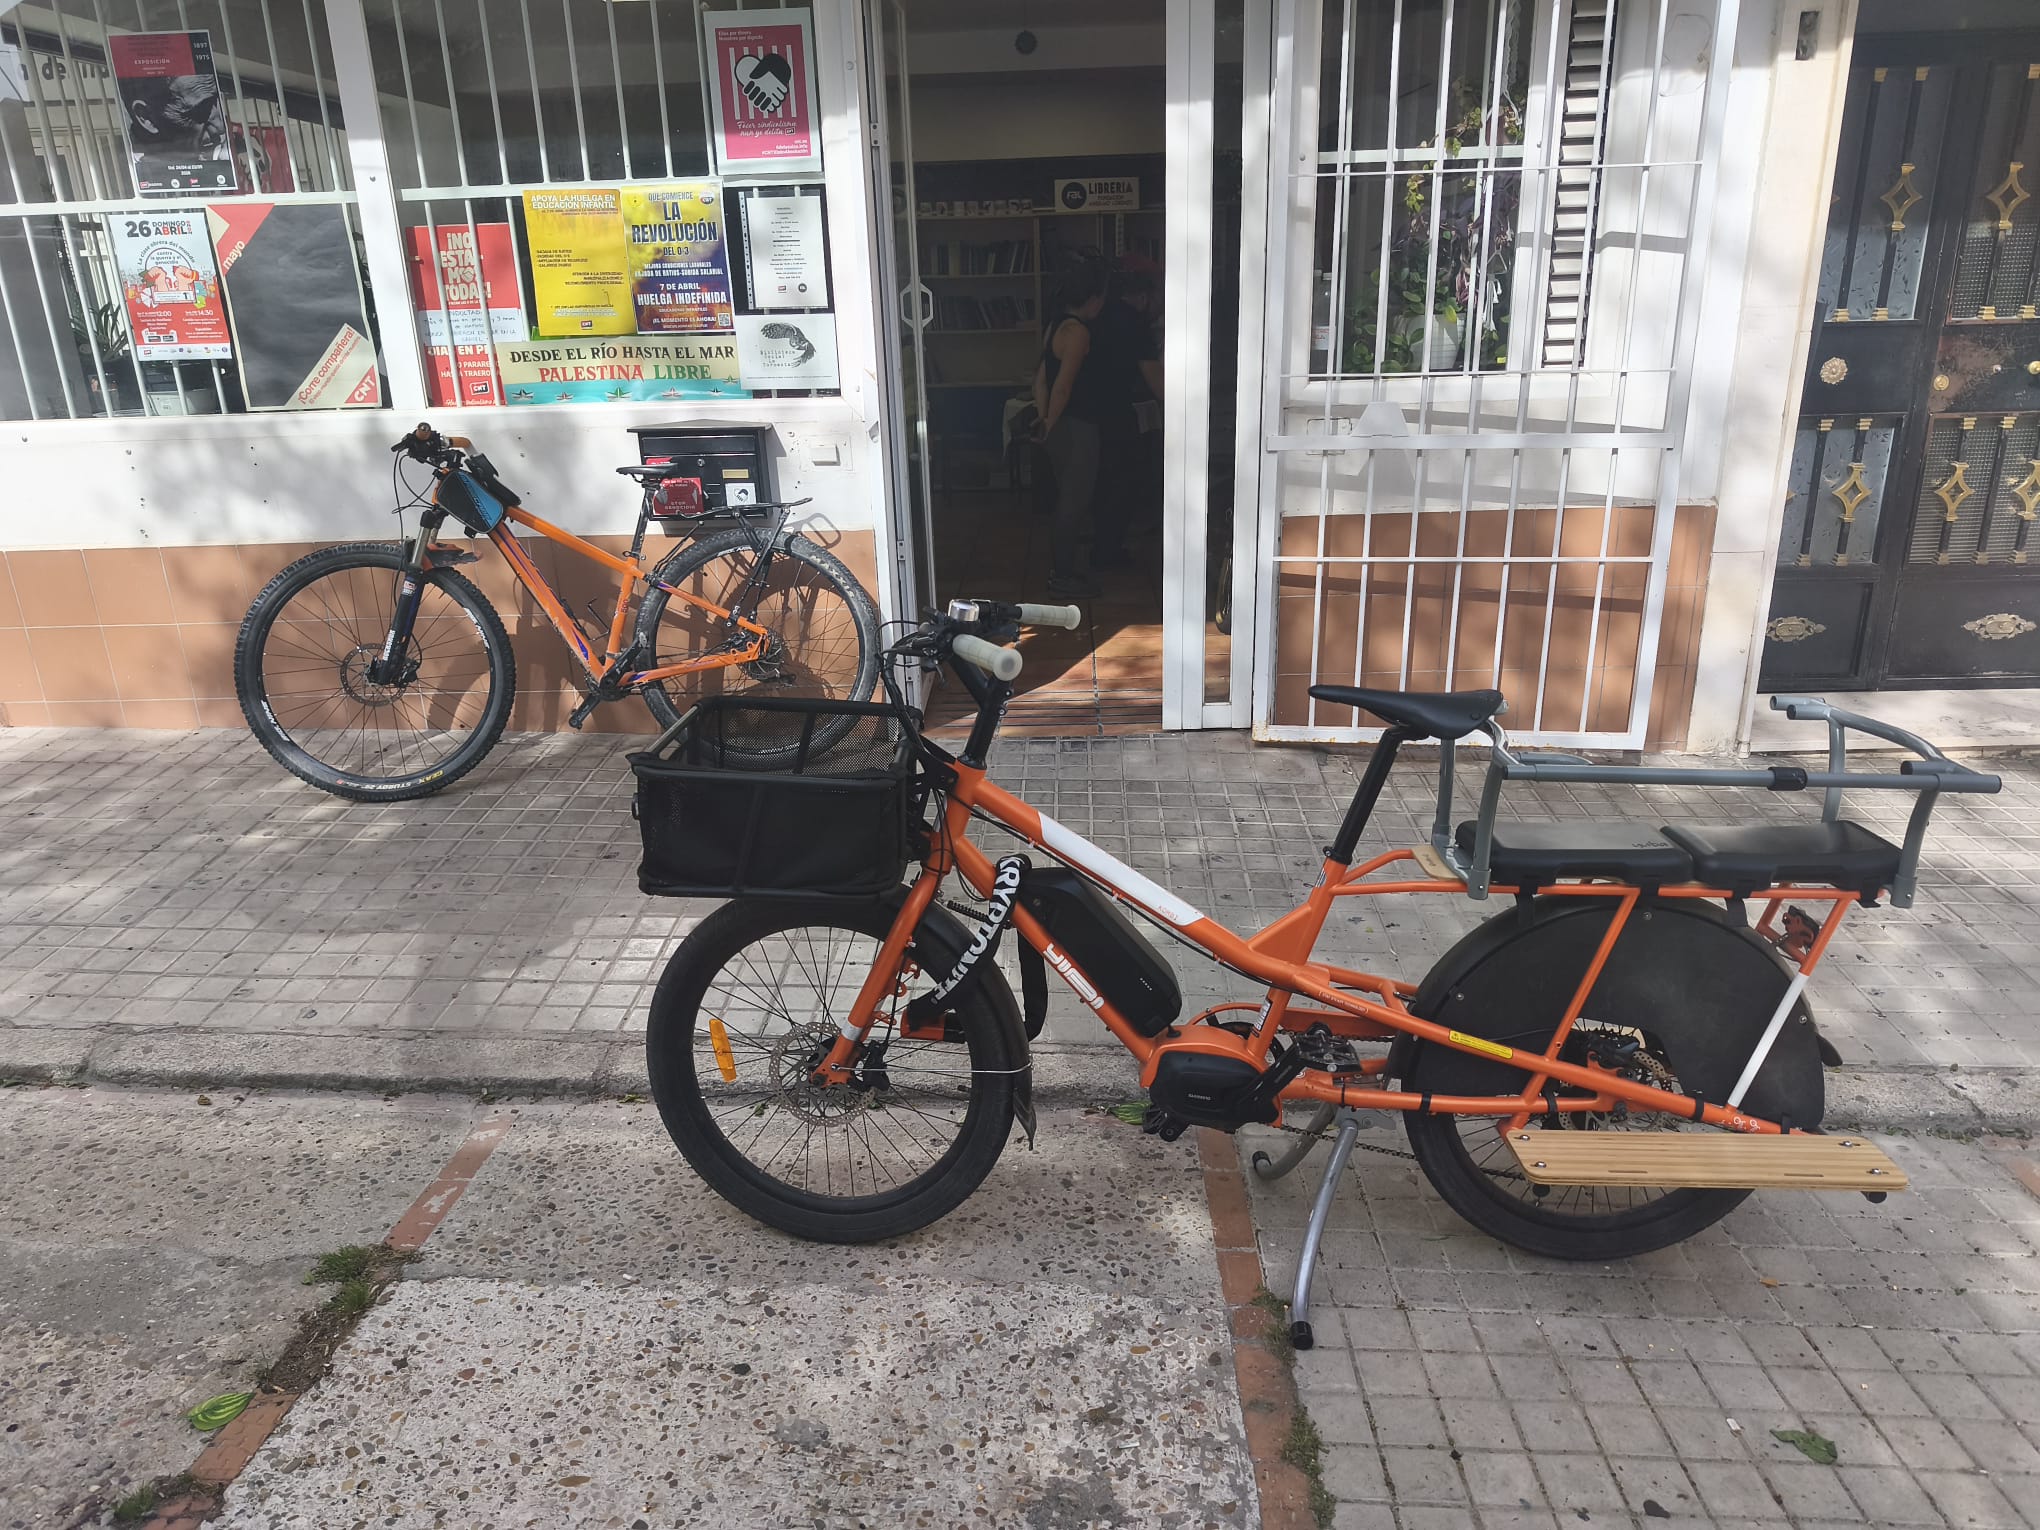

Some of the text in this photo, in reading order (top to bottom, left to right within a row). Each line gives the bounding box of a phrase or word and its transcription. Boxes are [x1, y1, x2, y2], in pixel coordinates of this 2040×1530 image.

[531, 194, 557, 202] APOYA
[560, 194, 571, 202] LA
[571, 194, 604, 202] HUELGA
[581, 200, 616, 209] INFANTIL
[648, 192, 660, 201] QUE
[662, 191, 693, 201] COMIENCE
[663, 201, 682, 221] LA
[124, 220, 186, 238] 26 DOMINGO
[154, 226, 188, 236] ABRIL
[631, 217, 719, 244] REVOLUCIÓN
[222, 239, 247, 271] mayo
[663, 247, 676, 256] DEL
[445, 281, 492, 301] TODA!
[659, 283, 665, 291] 7
[678, 282, 701, 290] ABRIL
[637, 291, 727, 306] HUELGA INDEFINIDA
[318, 326, 356, 379] compañera!
[511, 342, 735, 364] DESDE EL RÍO HASTA EL MAR
[539, 364, 712, 385] PALESTINA LIBRE
[353, 375, 377, 402] CNT
[473, 383, 487, 393] CNT
